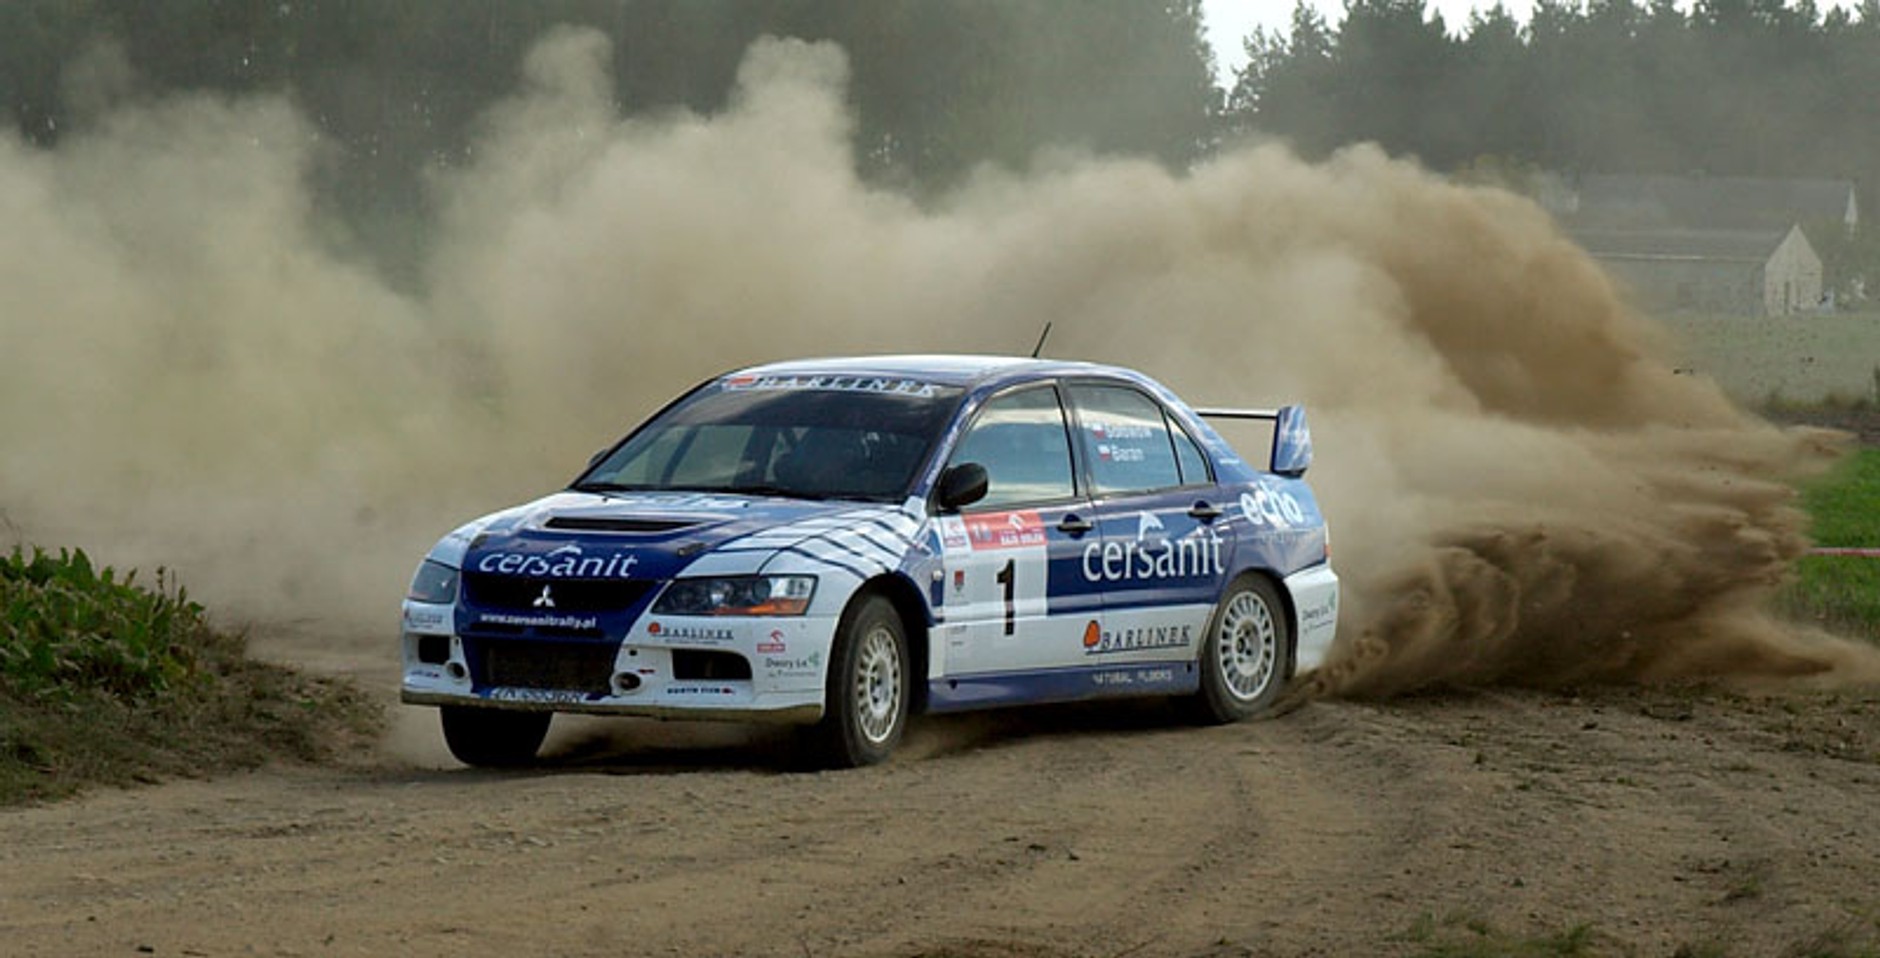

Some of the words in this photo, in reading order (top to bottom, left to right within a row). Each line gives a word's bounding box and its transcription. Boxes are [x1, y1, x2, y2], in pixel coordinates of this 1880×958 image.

[757, 375, 938, 398] BARLINEK
[1240, 480, 1304, 528] echo
[478, 551, 639, 579] cersanit
[1082, 530, 1224, 582] cersanit
[996, 558, 1015, 636] 1
[662, 626, 735, 640] BARLINEK
[1101, 624, 1191, 650] BARLINEK
